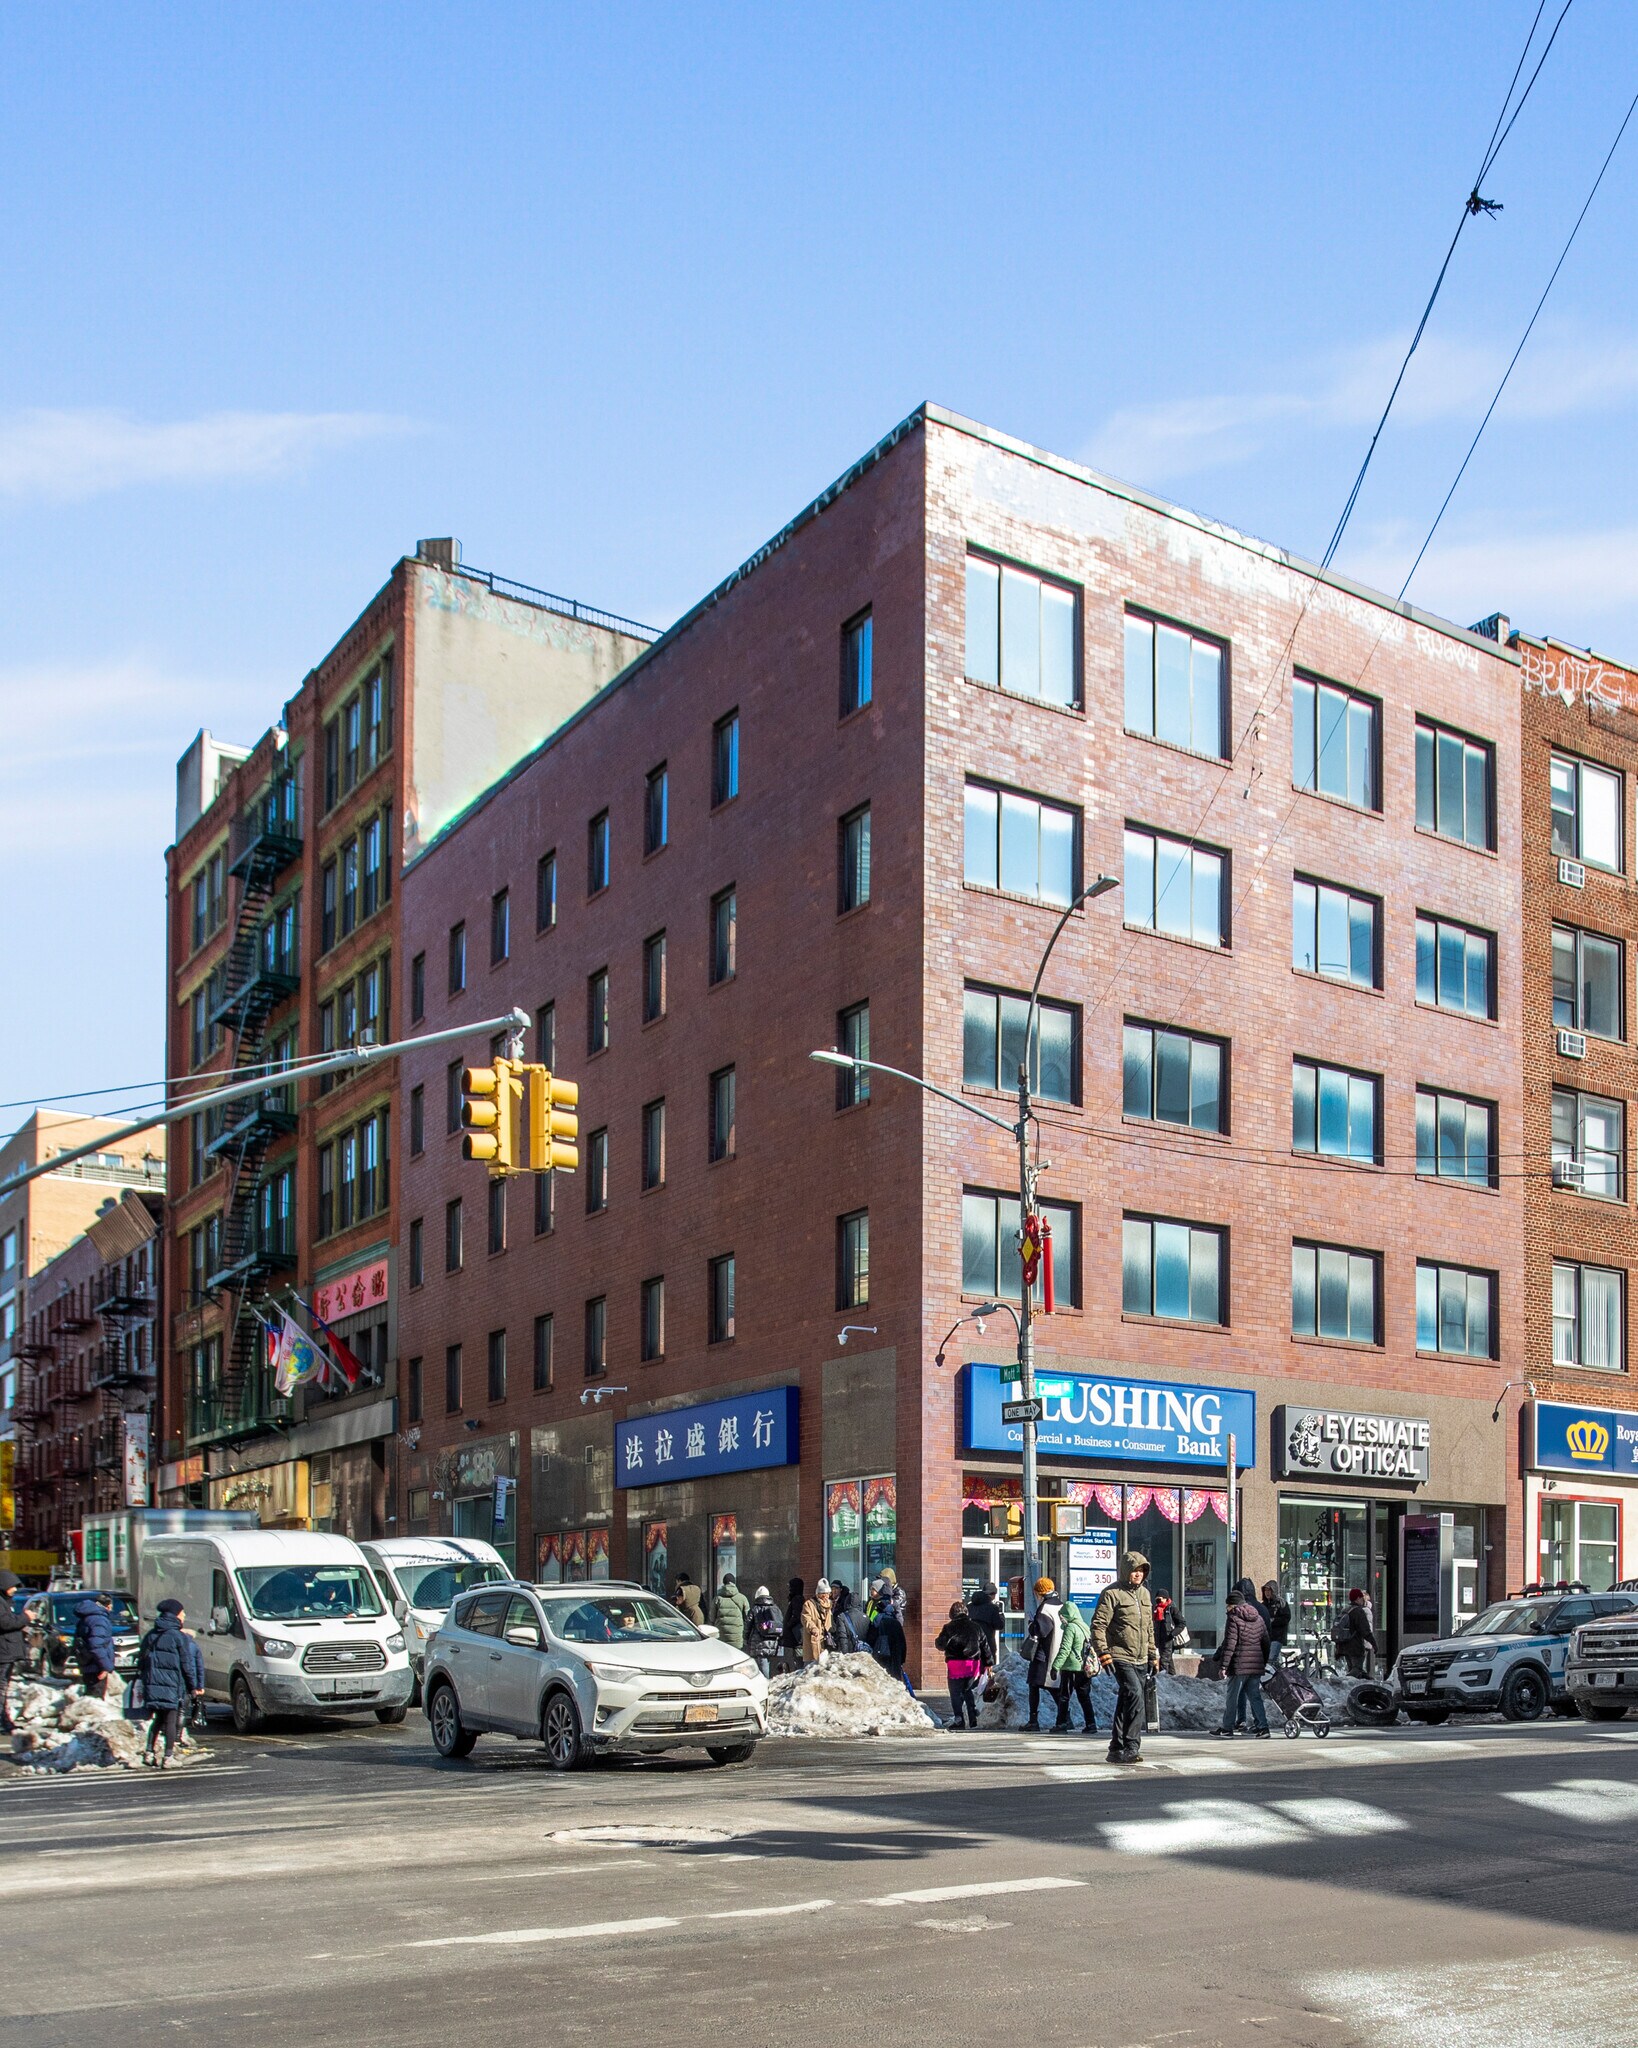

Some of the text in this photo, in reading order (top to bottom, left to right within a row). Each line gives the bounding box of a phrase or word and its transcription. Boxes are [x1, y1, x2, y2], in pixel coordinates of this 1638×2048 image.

[1003, 1368, 1016, 1381] Mott
[1007, 1405, 1037, 1418] ONE WAY
[1012, 1381, 1223, 1436] LUSHING
[625, 1409, 775, 1470] 法拉盛銀行
[1326, 1414, 1430, 1447] EYESMATE
[1073, 1434, 1112, 1448] Business
[1122, 1438, 1166, 1452] Consumer
[1176, 1435, 1222, 1457] Bank
[1336, 1443, 1421, 1474] OPTICAL
[1508, 1641, 1529, 1650] POLICE
